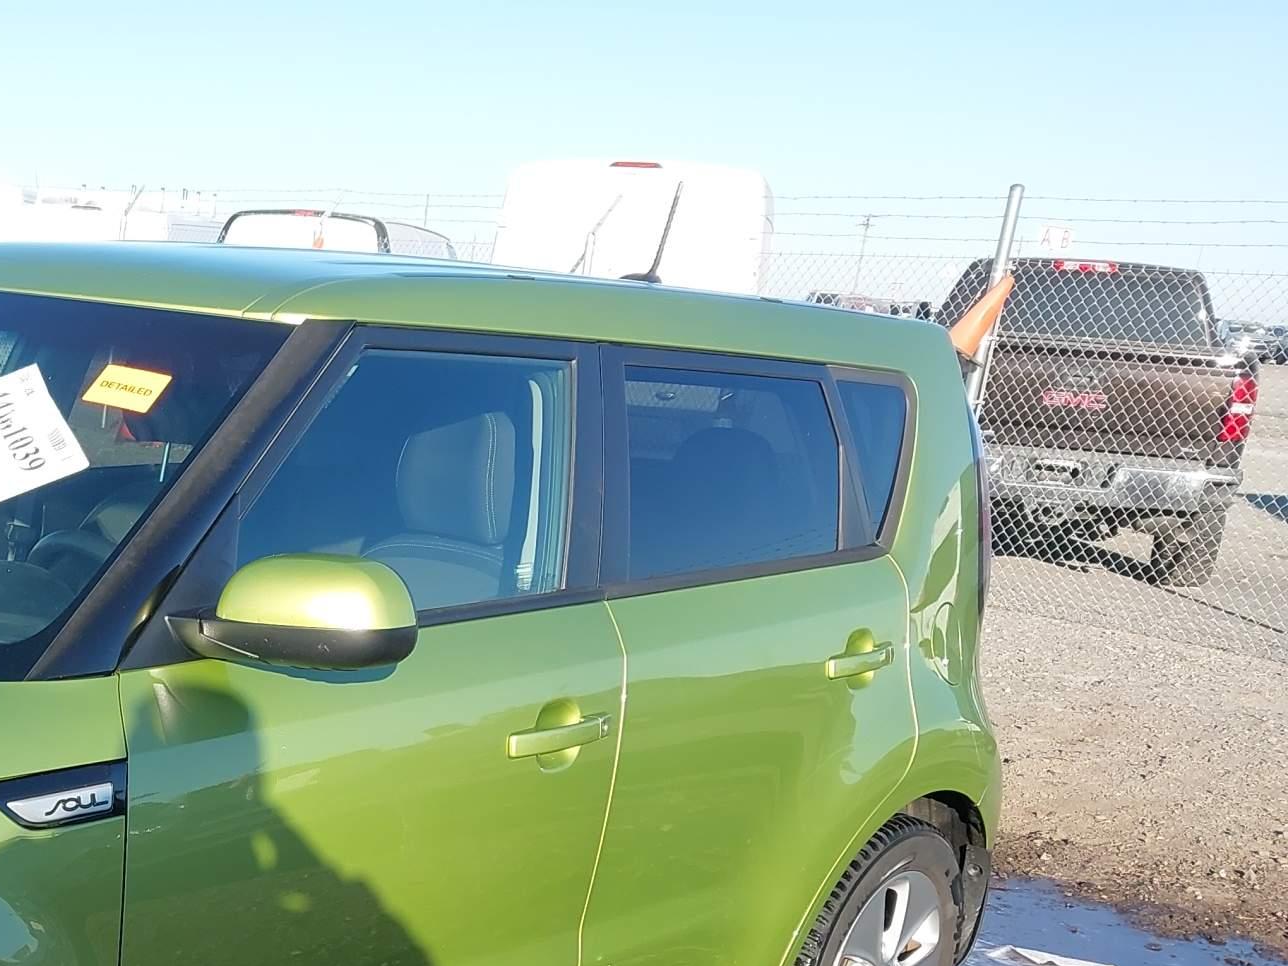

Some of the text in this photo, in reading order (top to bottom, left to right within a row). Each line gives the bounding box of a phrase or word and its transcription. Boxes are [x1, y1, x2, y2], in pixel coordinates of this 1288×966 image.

[99, 380, 153, 397] DETAILED
[1042, 390, 1107, 409] GMC
[45, 793, 108, 816] SOUL
